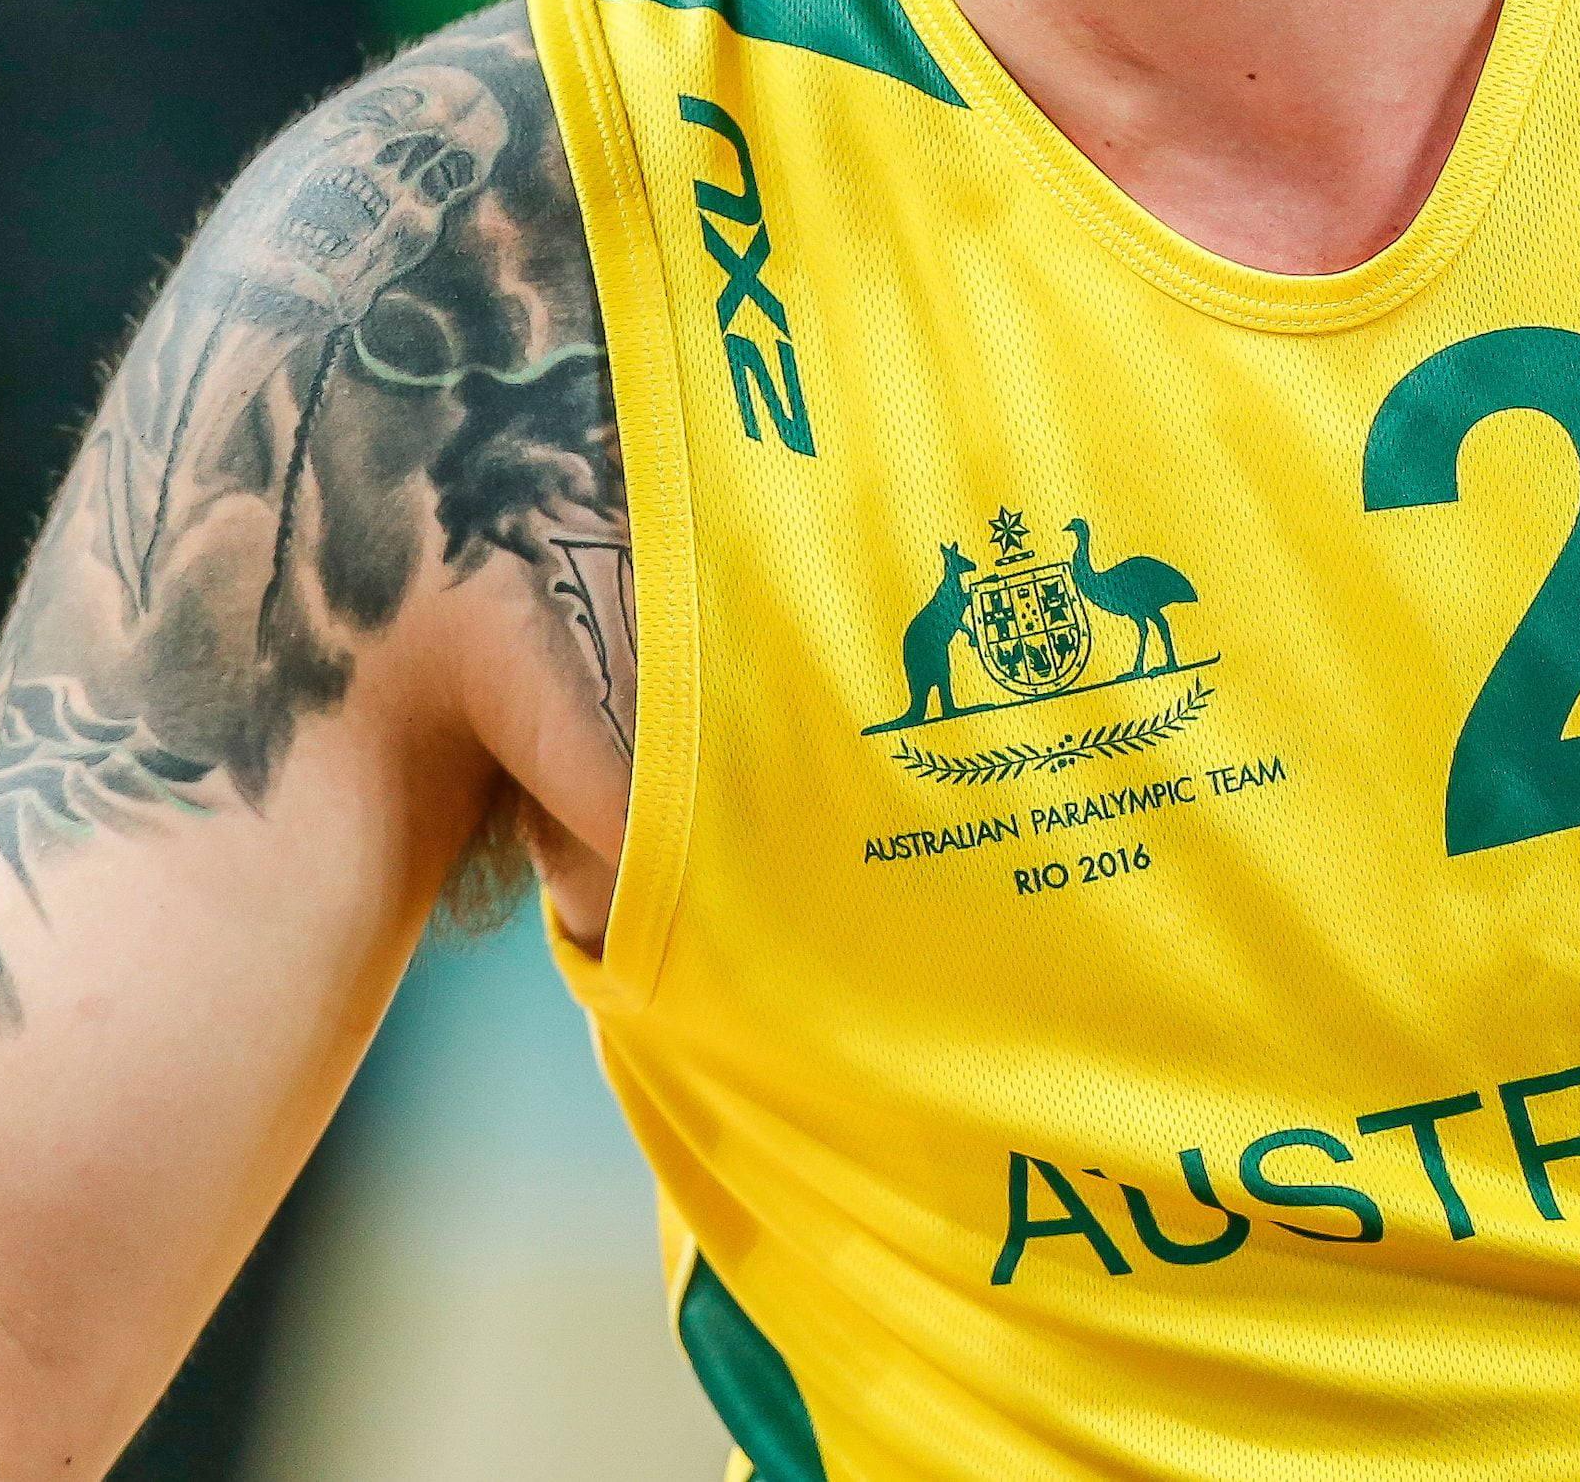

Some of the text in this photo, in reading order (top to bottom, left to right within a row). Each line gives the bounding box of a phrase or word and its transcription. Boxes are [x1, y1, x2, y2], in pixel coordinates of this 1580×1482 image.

[678, 94, 817, 457] 2XU
[864, 755, 1287, 864] AUSTRALIAN PARALYMPIC TEAM
[1013, 842, 1152, 895] RIO 2016
